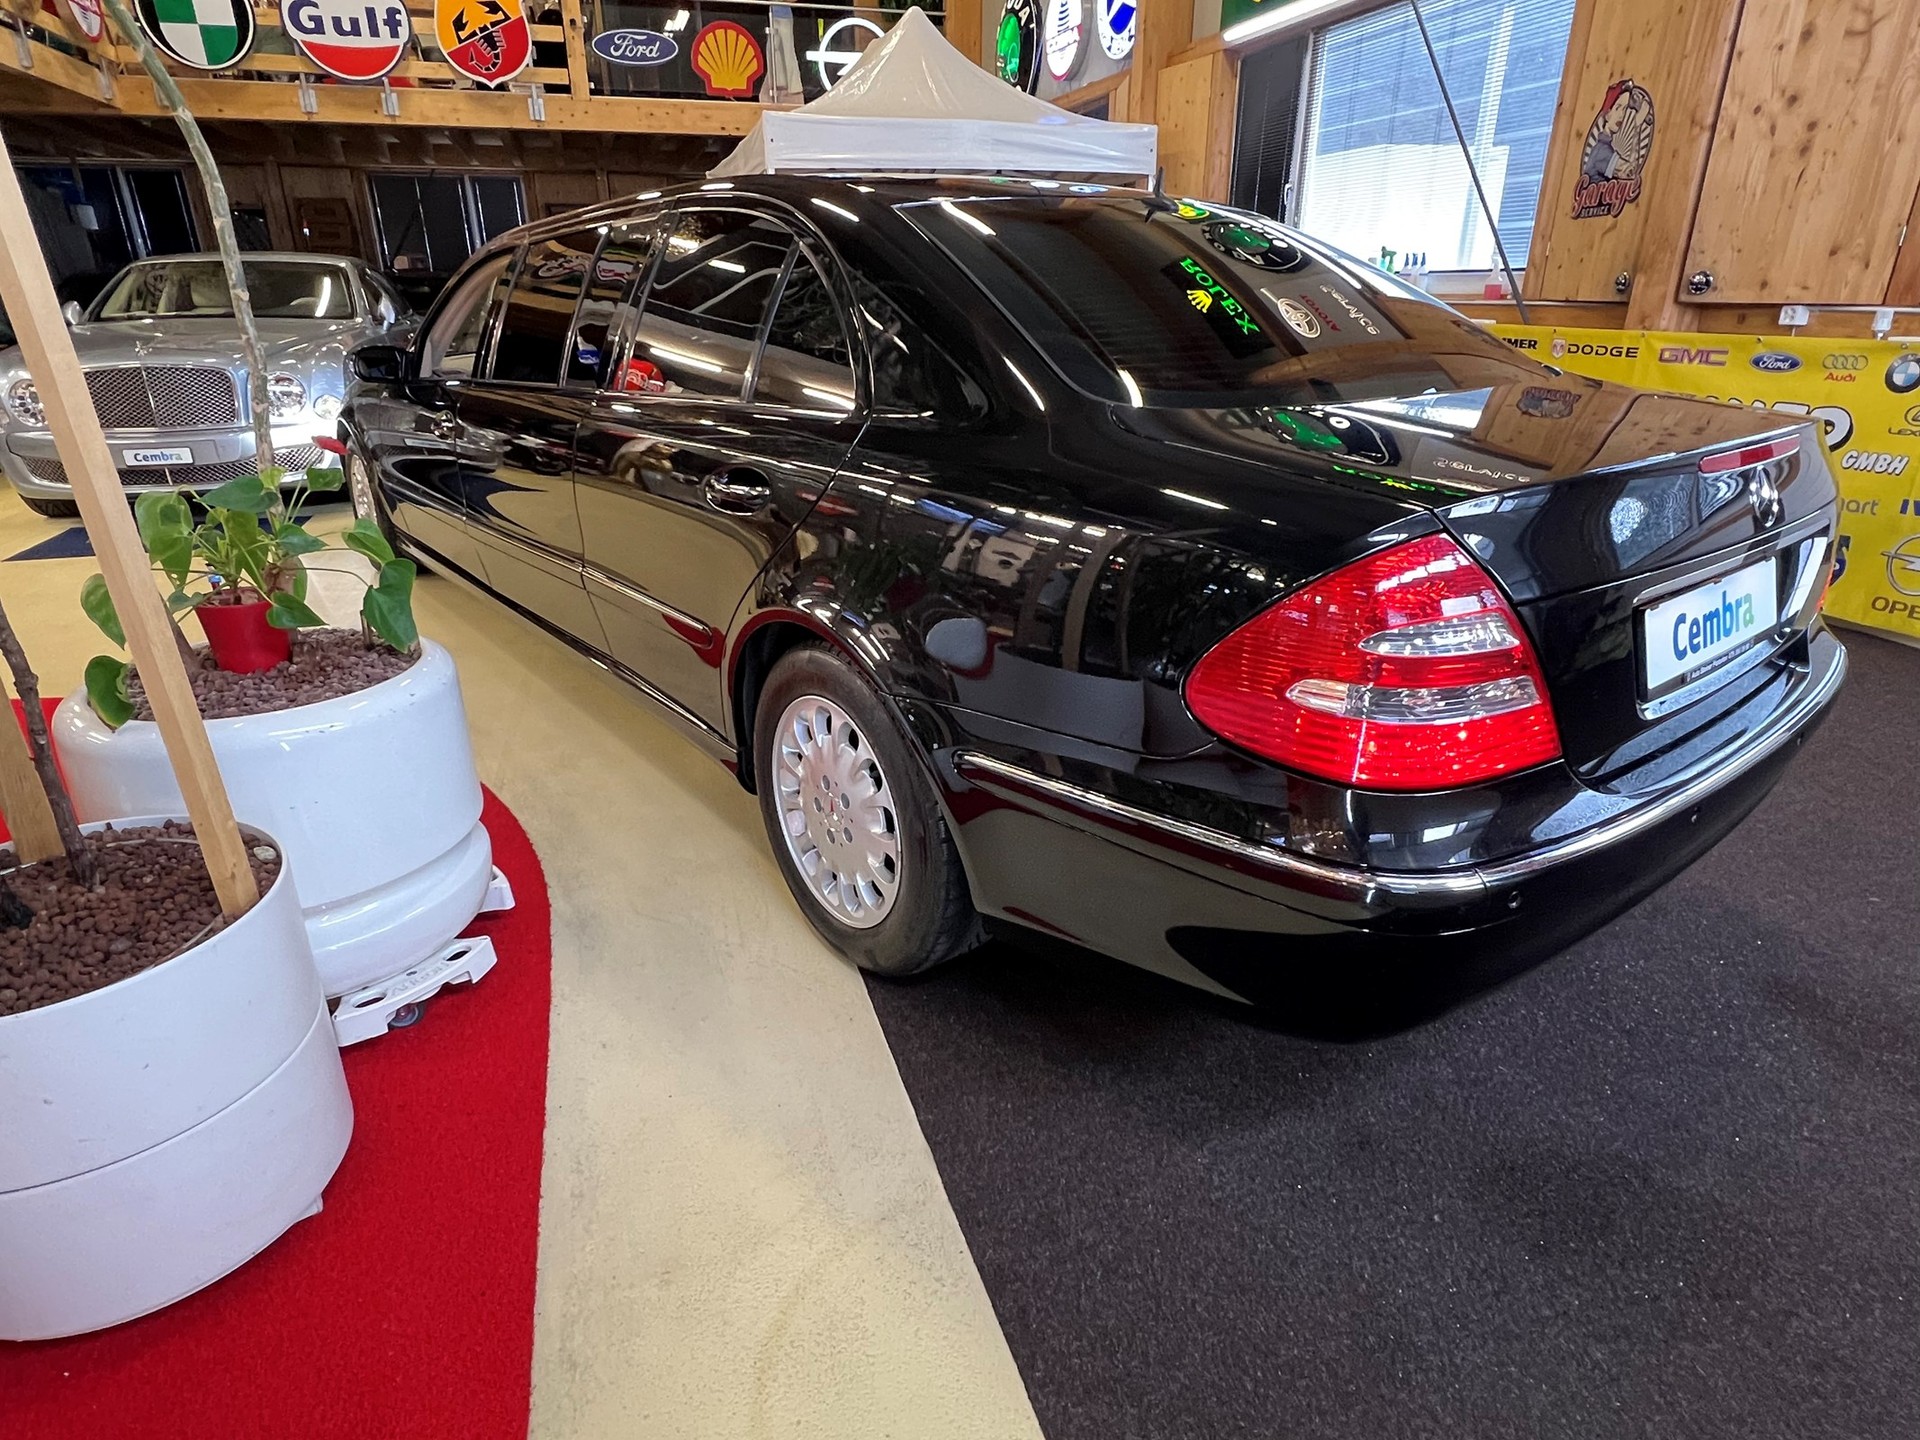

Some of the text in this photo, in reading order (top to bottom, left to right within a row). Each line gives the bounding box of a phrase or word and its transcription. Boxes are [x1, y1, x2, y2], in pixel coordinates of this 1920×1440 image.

[287, 0, 403, 39] Gulf
[609, 32, 661, 59] Ford
[1572, 174, 1641, 217] Garage
[1566, 342, 1640, 359] DODGE
[1658, 347, 1730, 367] GMC
[1758, 352, 1793, 370] Ford
[1824, 371, 1857, 383] Audi
[1888, 427, 1920, 437] LEX
[133, 450, 184, 463] Cembra
[1841, 450, 1909, 476] GMBH
[1842, 498, 1881, 516] art
[1871, 596, 1920, 621] OPE
[1672, 590, 1755, 662] Cembra
